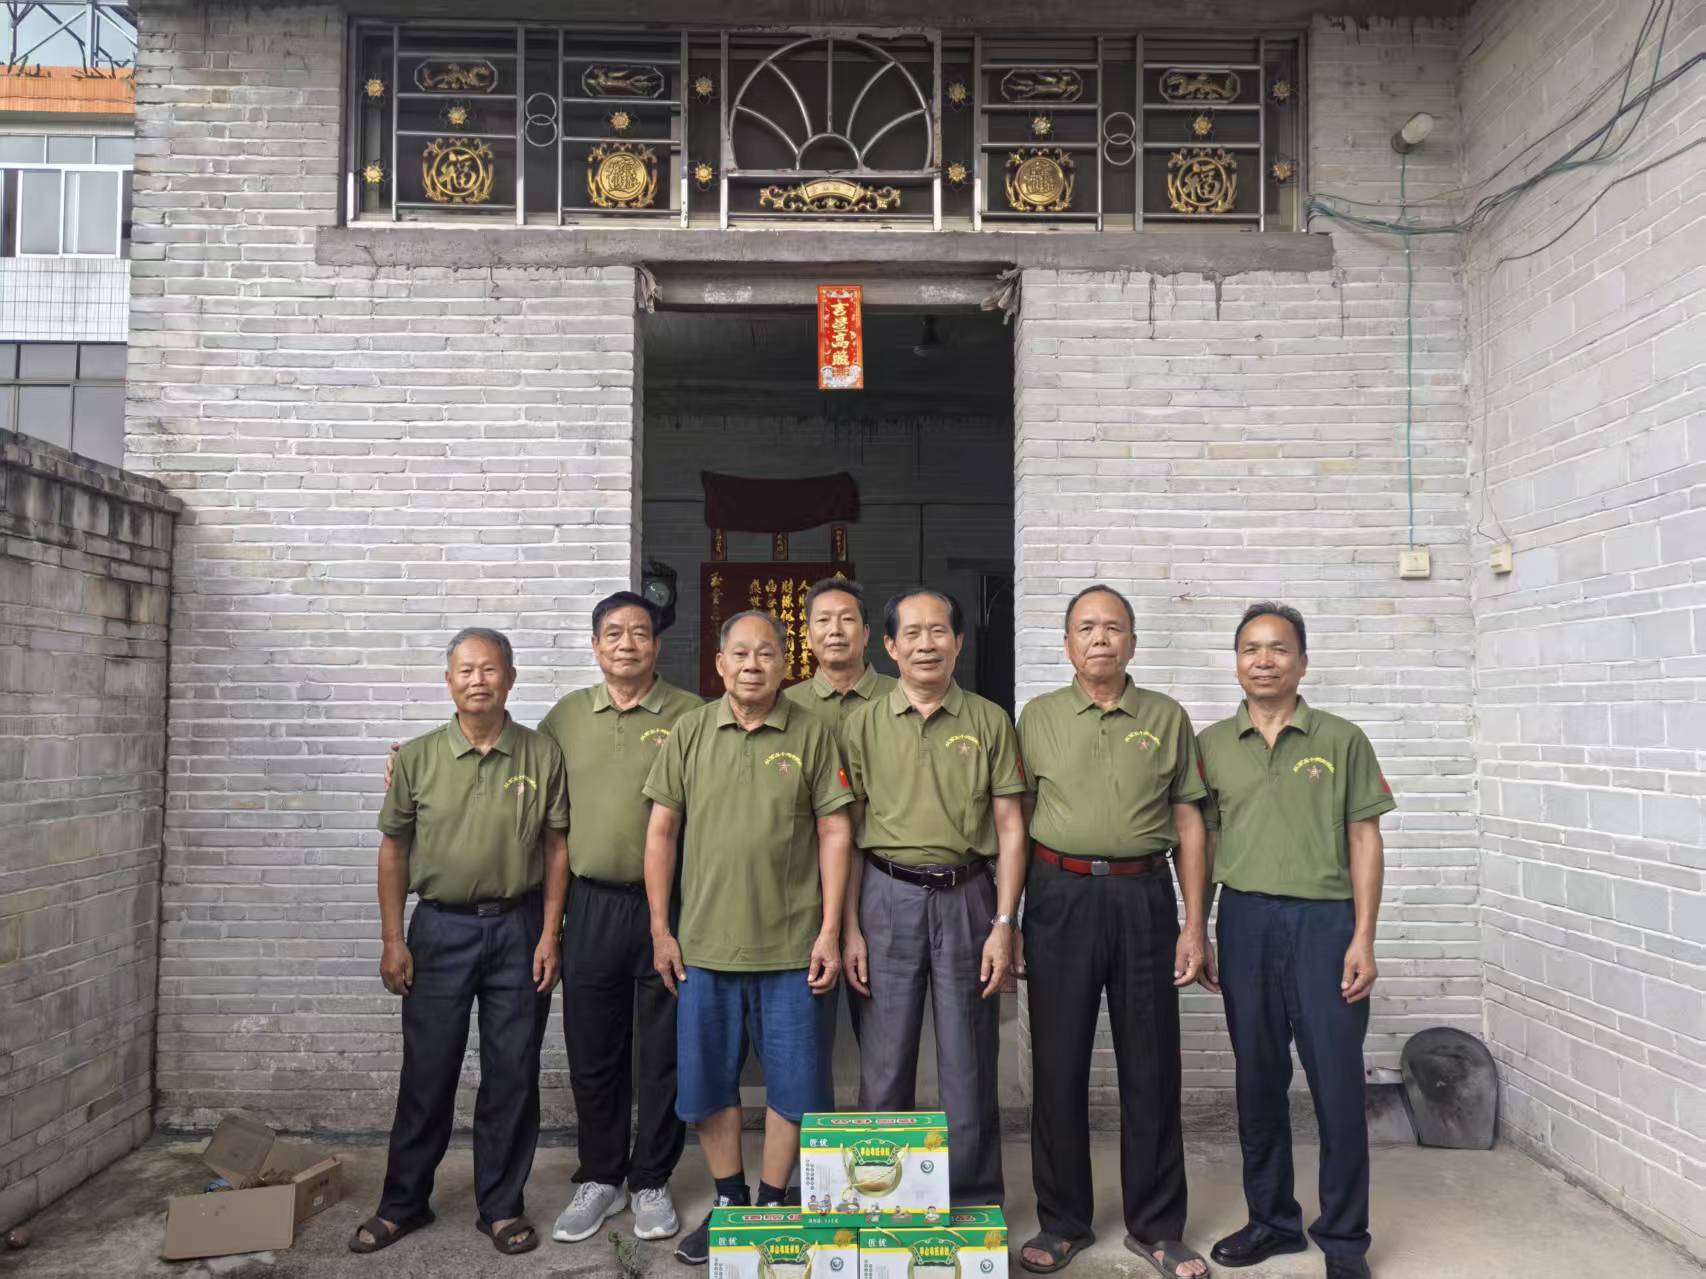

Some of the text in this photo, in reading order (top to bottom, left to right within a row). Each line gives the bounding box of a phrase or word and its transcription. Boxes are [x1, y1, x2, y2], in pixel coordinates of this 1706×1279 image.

[438, 151, 477, 193] 福
[1182, 162, 1221, 202] 福
[831, 301, 850, 366] 吉星高照
